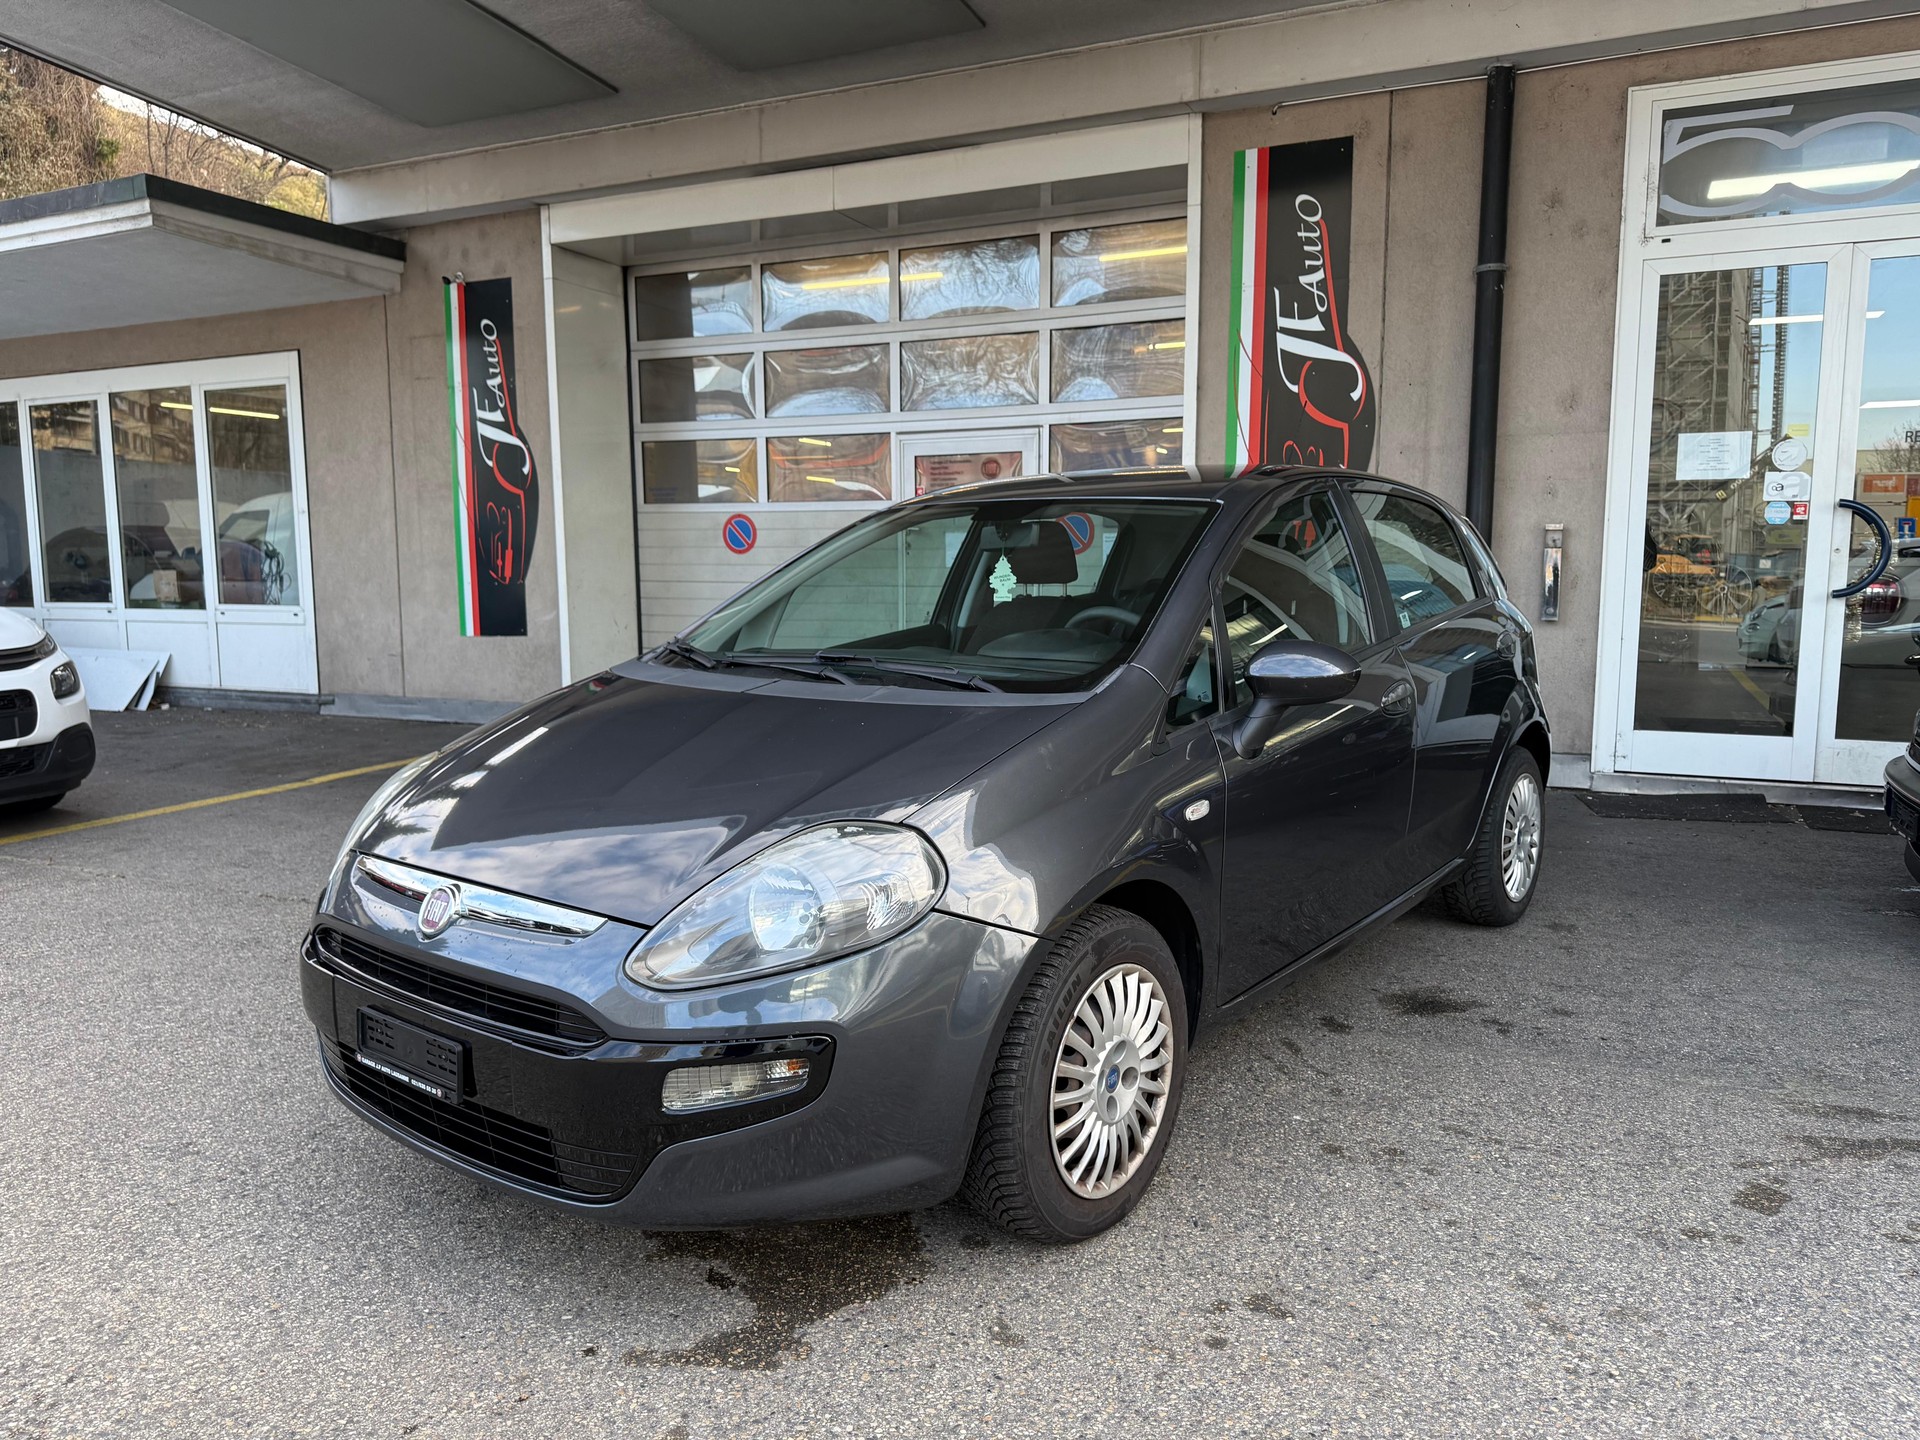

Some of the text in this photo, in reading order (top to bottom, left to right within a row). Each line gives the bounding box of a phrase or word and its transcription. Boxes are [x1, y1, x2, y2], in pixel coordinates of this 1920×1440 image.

[424, 898, 448, 923] FIAT
[1040, 972, 1083, 1068] SAILUN
[1107, 1072, 1118, 1086] FIAT
